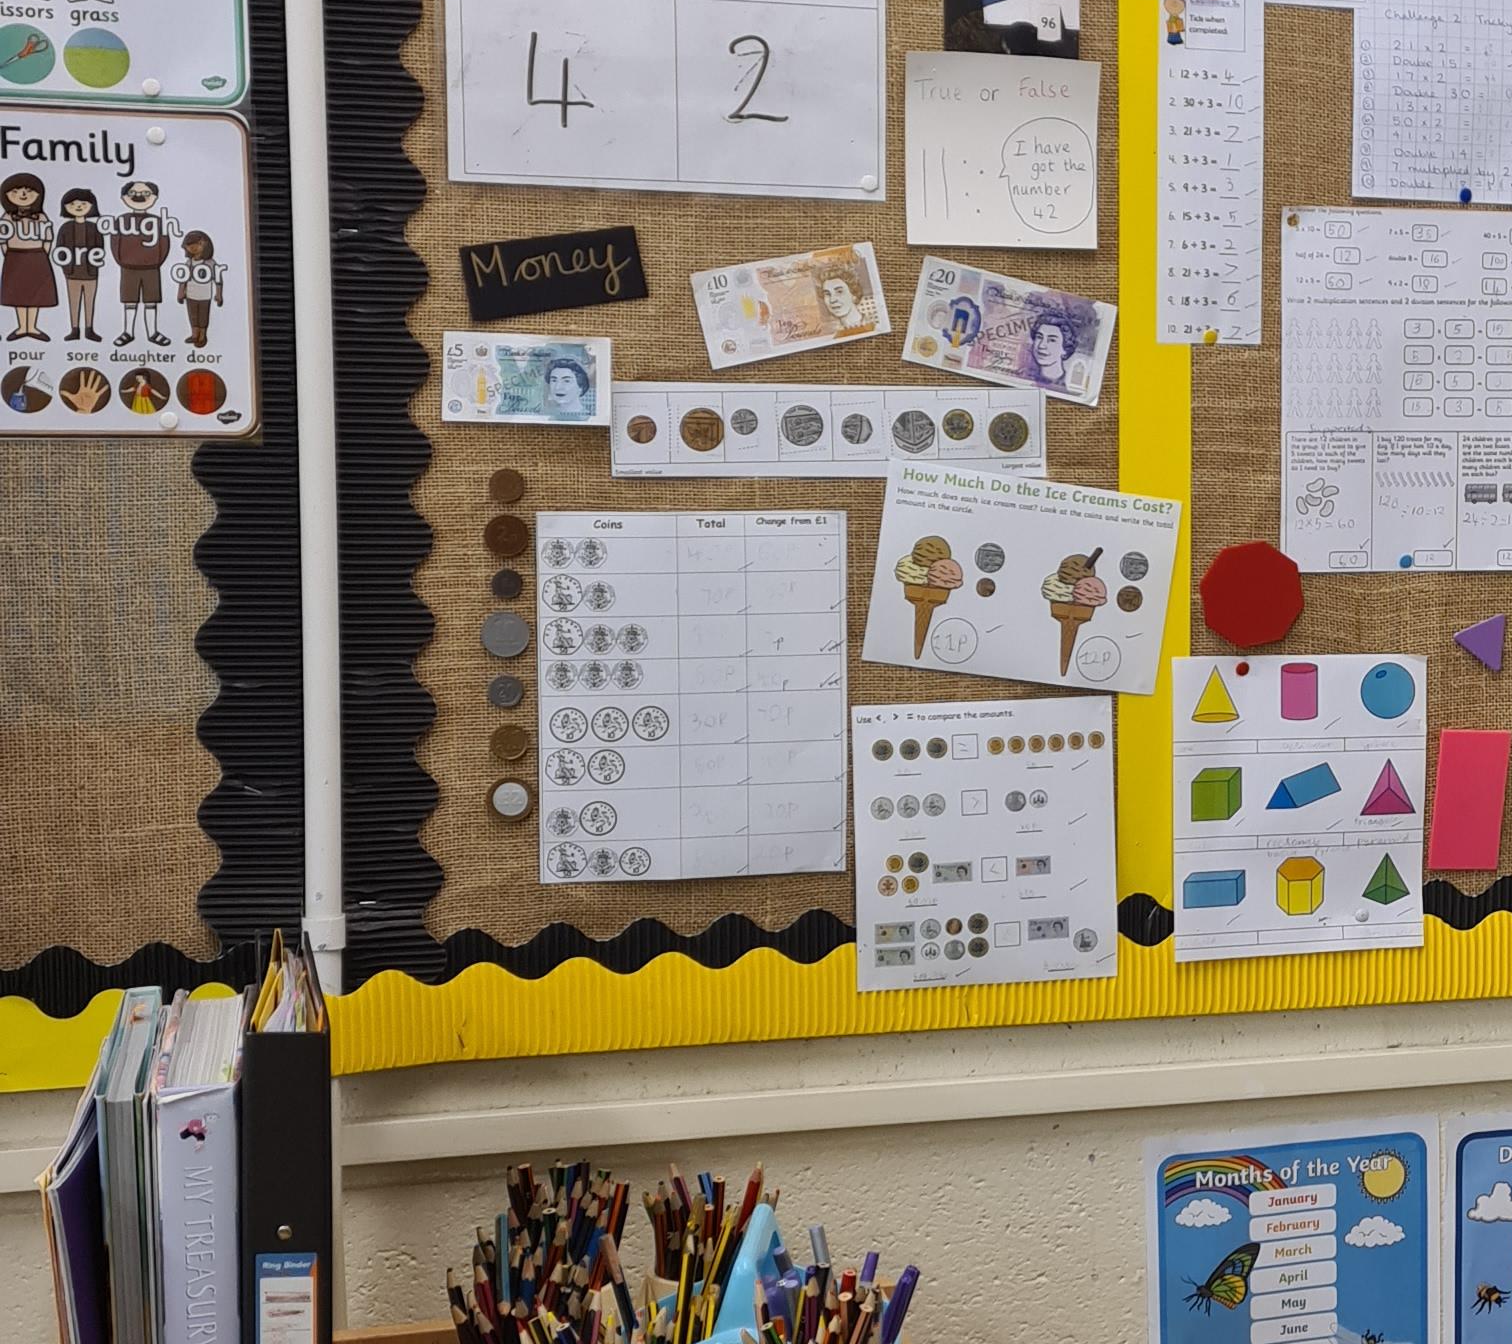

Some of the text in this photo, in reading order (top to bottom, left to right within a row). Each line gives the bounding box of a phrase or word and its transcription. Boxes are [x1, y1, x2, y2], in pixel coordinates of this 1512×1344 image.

[70, 9, 119, 26] grass
[0, 126, 134, 177] Family
[97, 207, 183, 246] augh
[471, 241, 633, 293] Money
[9, 349, 222, 366] pour sore daughter door
[903, 468, 1173, 515] How Much Do the Ice Creams Cost?
[593, 516, 827, 529] Coins Total Change from £1
[1195, 1153, 1393, 1190] Months of the Year
[183, 1165, 213, 1204] MY
[1267, 1191, 1318, 1208] January
[1266, 1217, 1320, 1234] February
[1274, 1242, 1312, 1258] March
[1279, 1268, 1309, 1285] April
[1281, 1295, 1306, 1312] May
[1280, 1322, 1309, 1336] June
